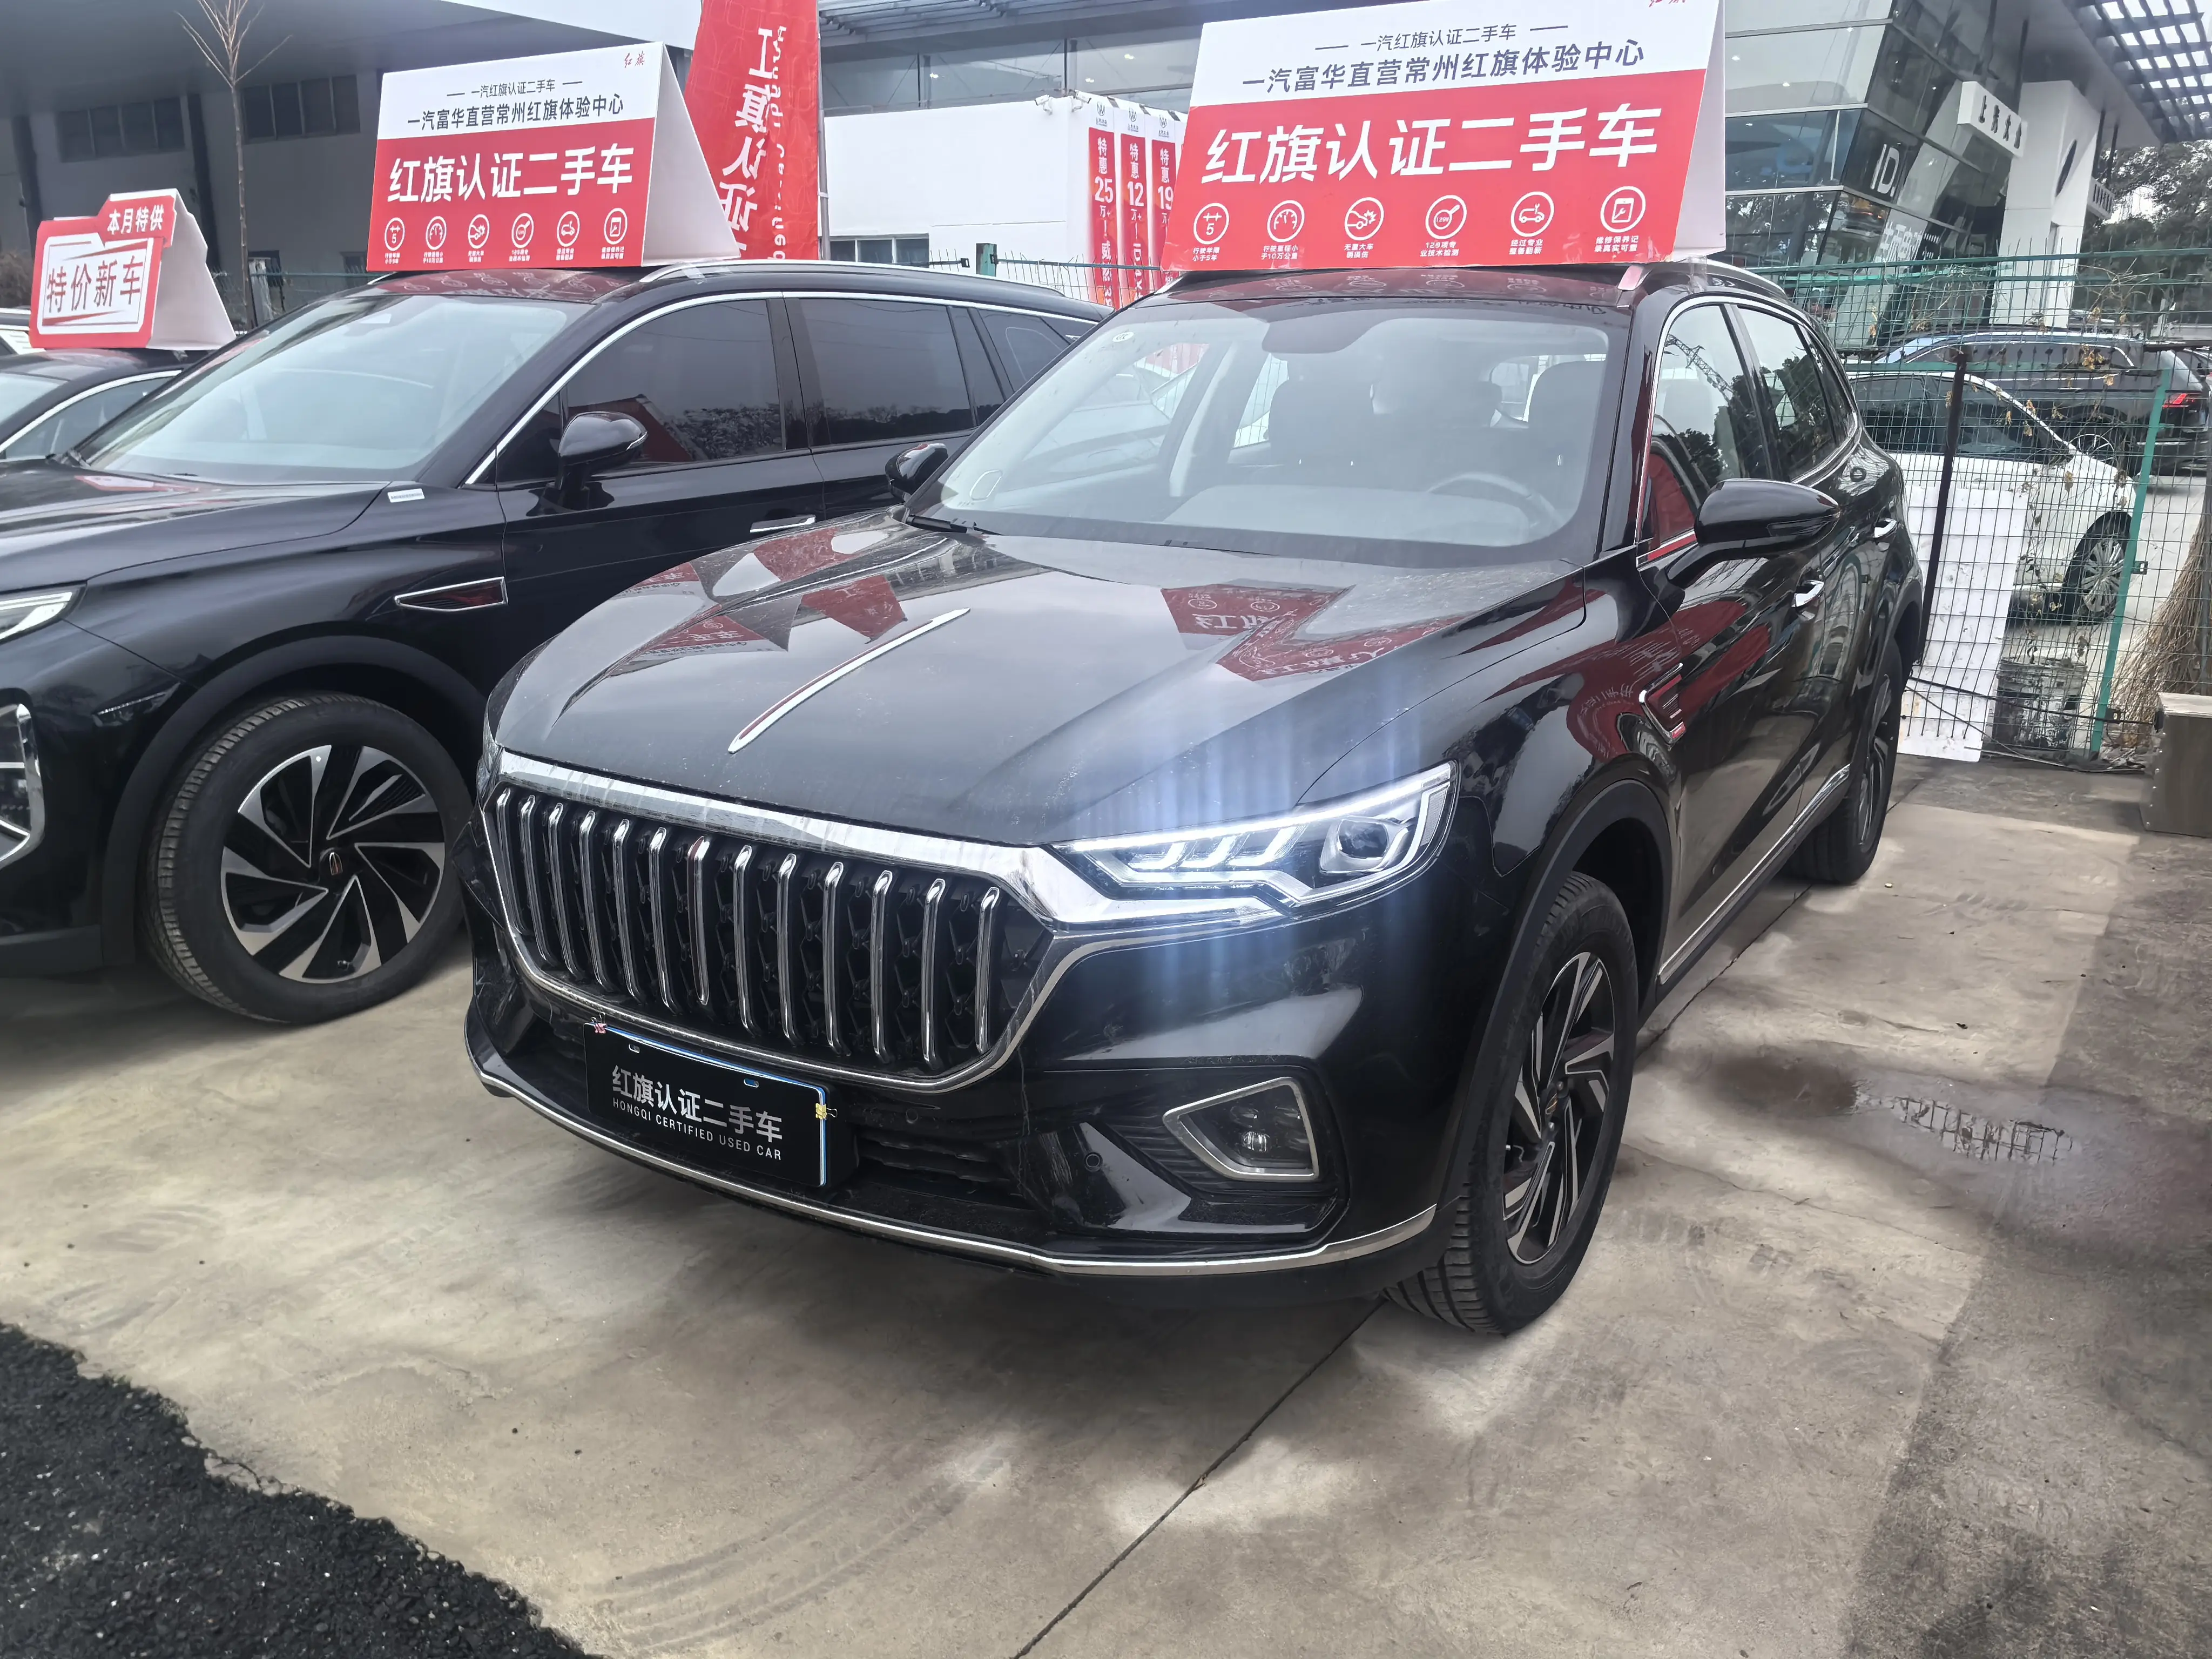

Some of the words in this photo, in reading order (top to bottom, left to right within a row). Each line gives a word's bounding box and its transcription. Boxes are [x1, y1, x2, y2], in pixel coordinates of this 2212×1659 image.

[1242, 38, 1644, 94] 一汽富华直营常州红旗体验中心
[1360, 23, 1518, 52] 一汽红旗认证二手车
[407, 93, 624, 131] 一汽富华直营常州红旗体验中心
[471, 79, 556, 98] 一汽红旗认证二手车
[1201, 102, 1662, 185] 红旗认证二手车
[387, 143, 635, 204] 红旗认证二手车
[107, 204, 164, 235] 本月特供
[46, 255, 144, 313] 特价新车
[612, 1064, 783, 1143] 红旗认证二手车
[612, 1097, 651, 1122] HONGQI
[656, 1115, 713, 1141] CERTIFIED
[719, 1134, 751, 1152] USED
[757, 1145, 781, 1161] CAR
